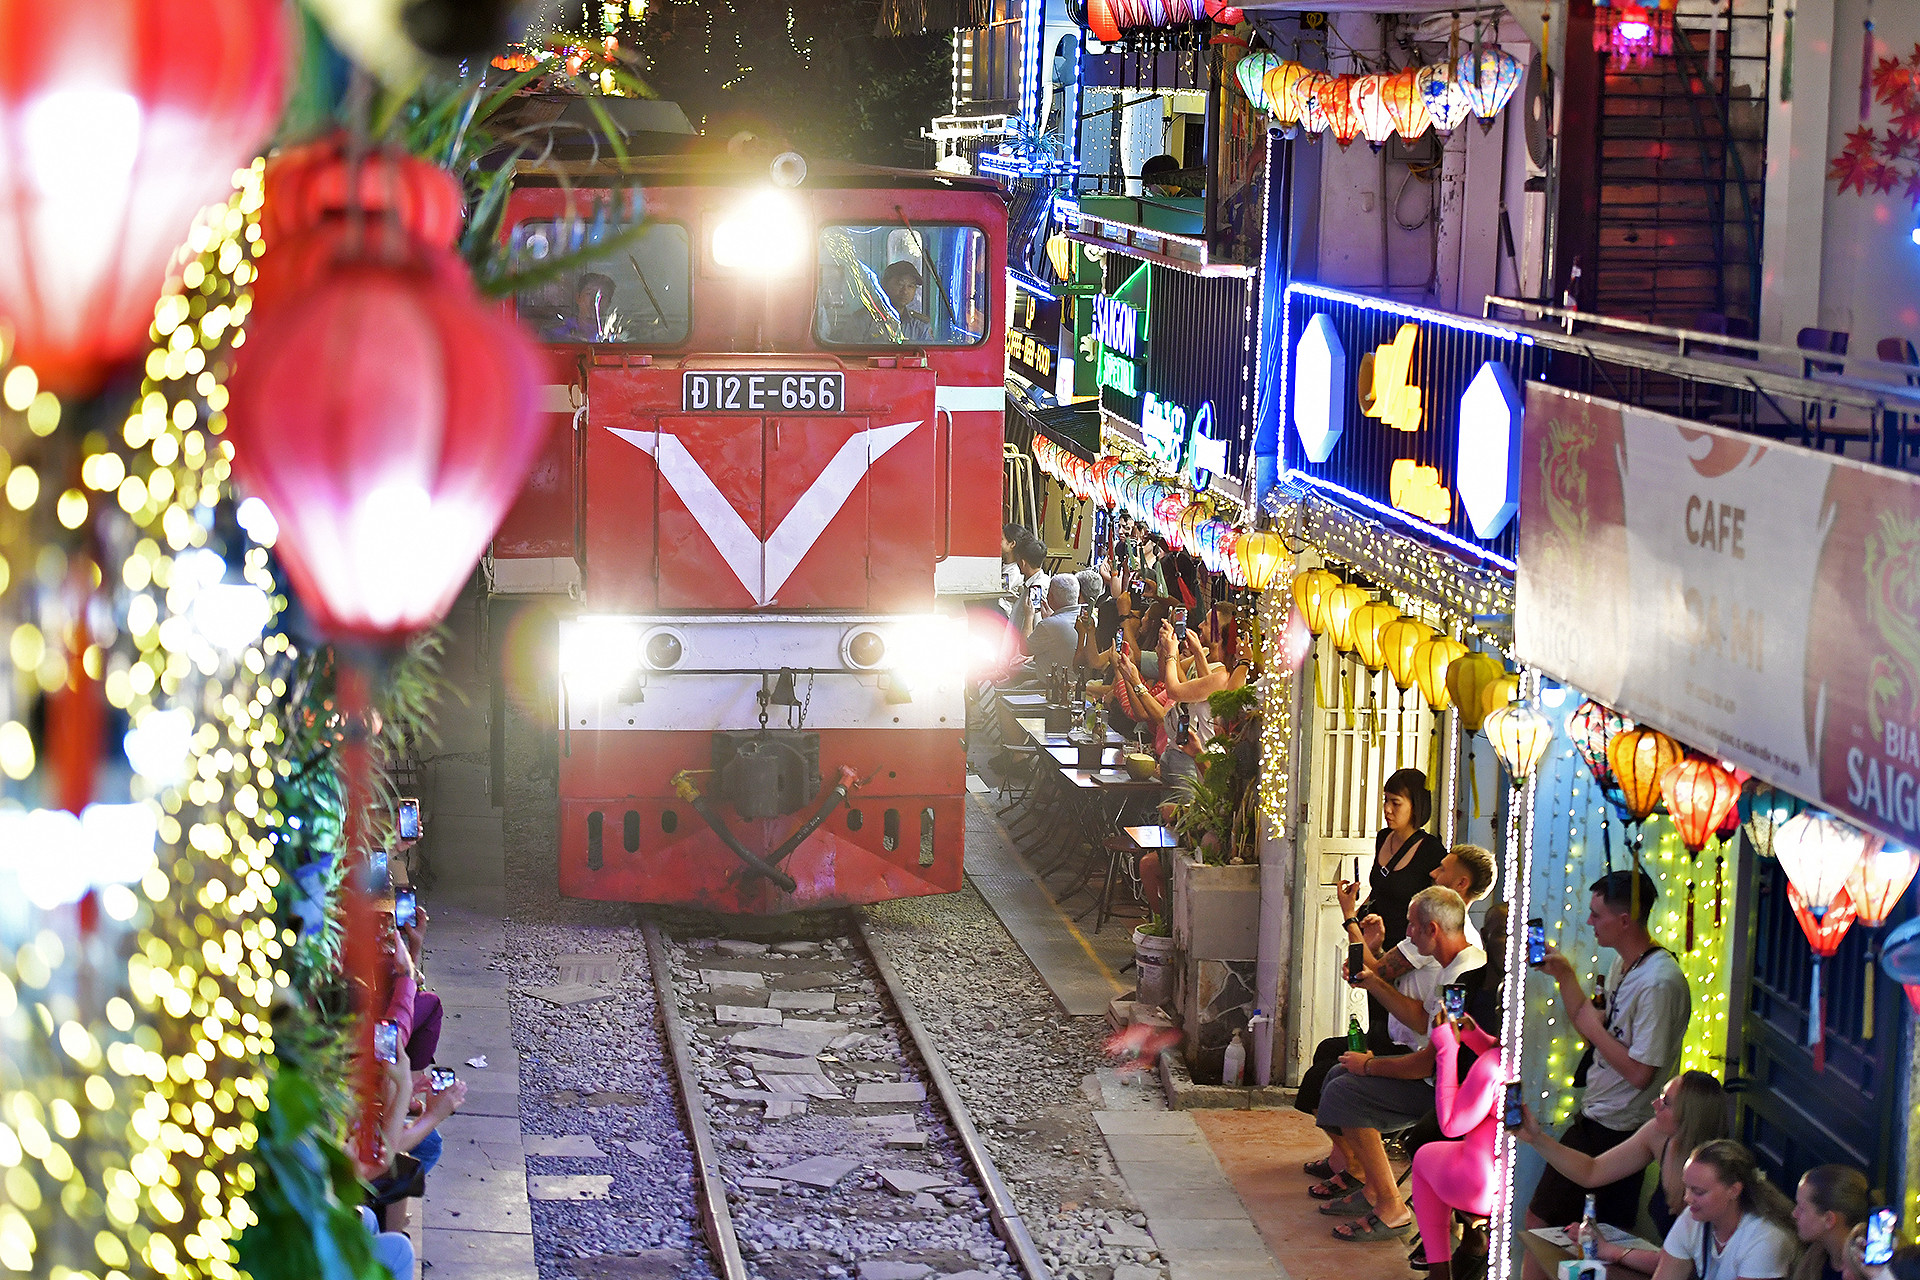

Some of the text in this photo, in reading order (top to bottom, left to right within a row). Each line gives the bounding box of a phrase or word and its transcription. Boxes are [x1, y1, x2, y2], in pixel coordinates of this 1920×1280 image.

[1097, 293, 1137, 359] SAIGON
[1685, 494, 1745, 560] CAFE
[1885, 720, 1920, 768] BIA
[1847, 746, 1920, 832] SAIG
